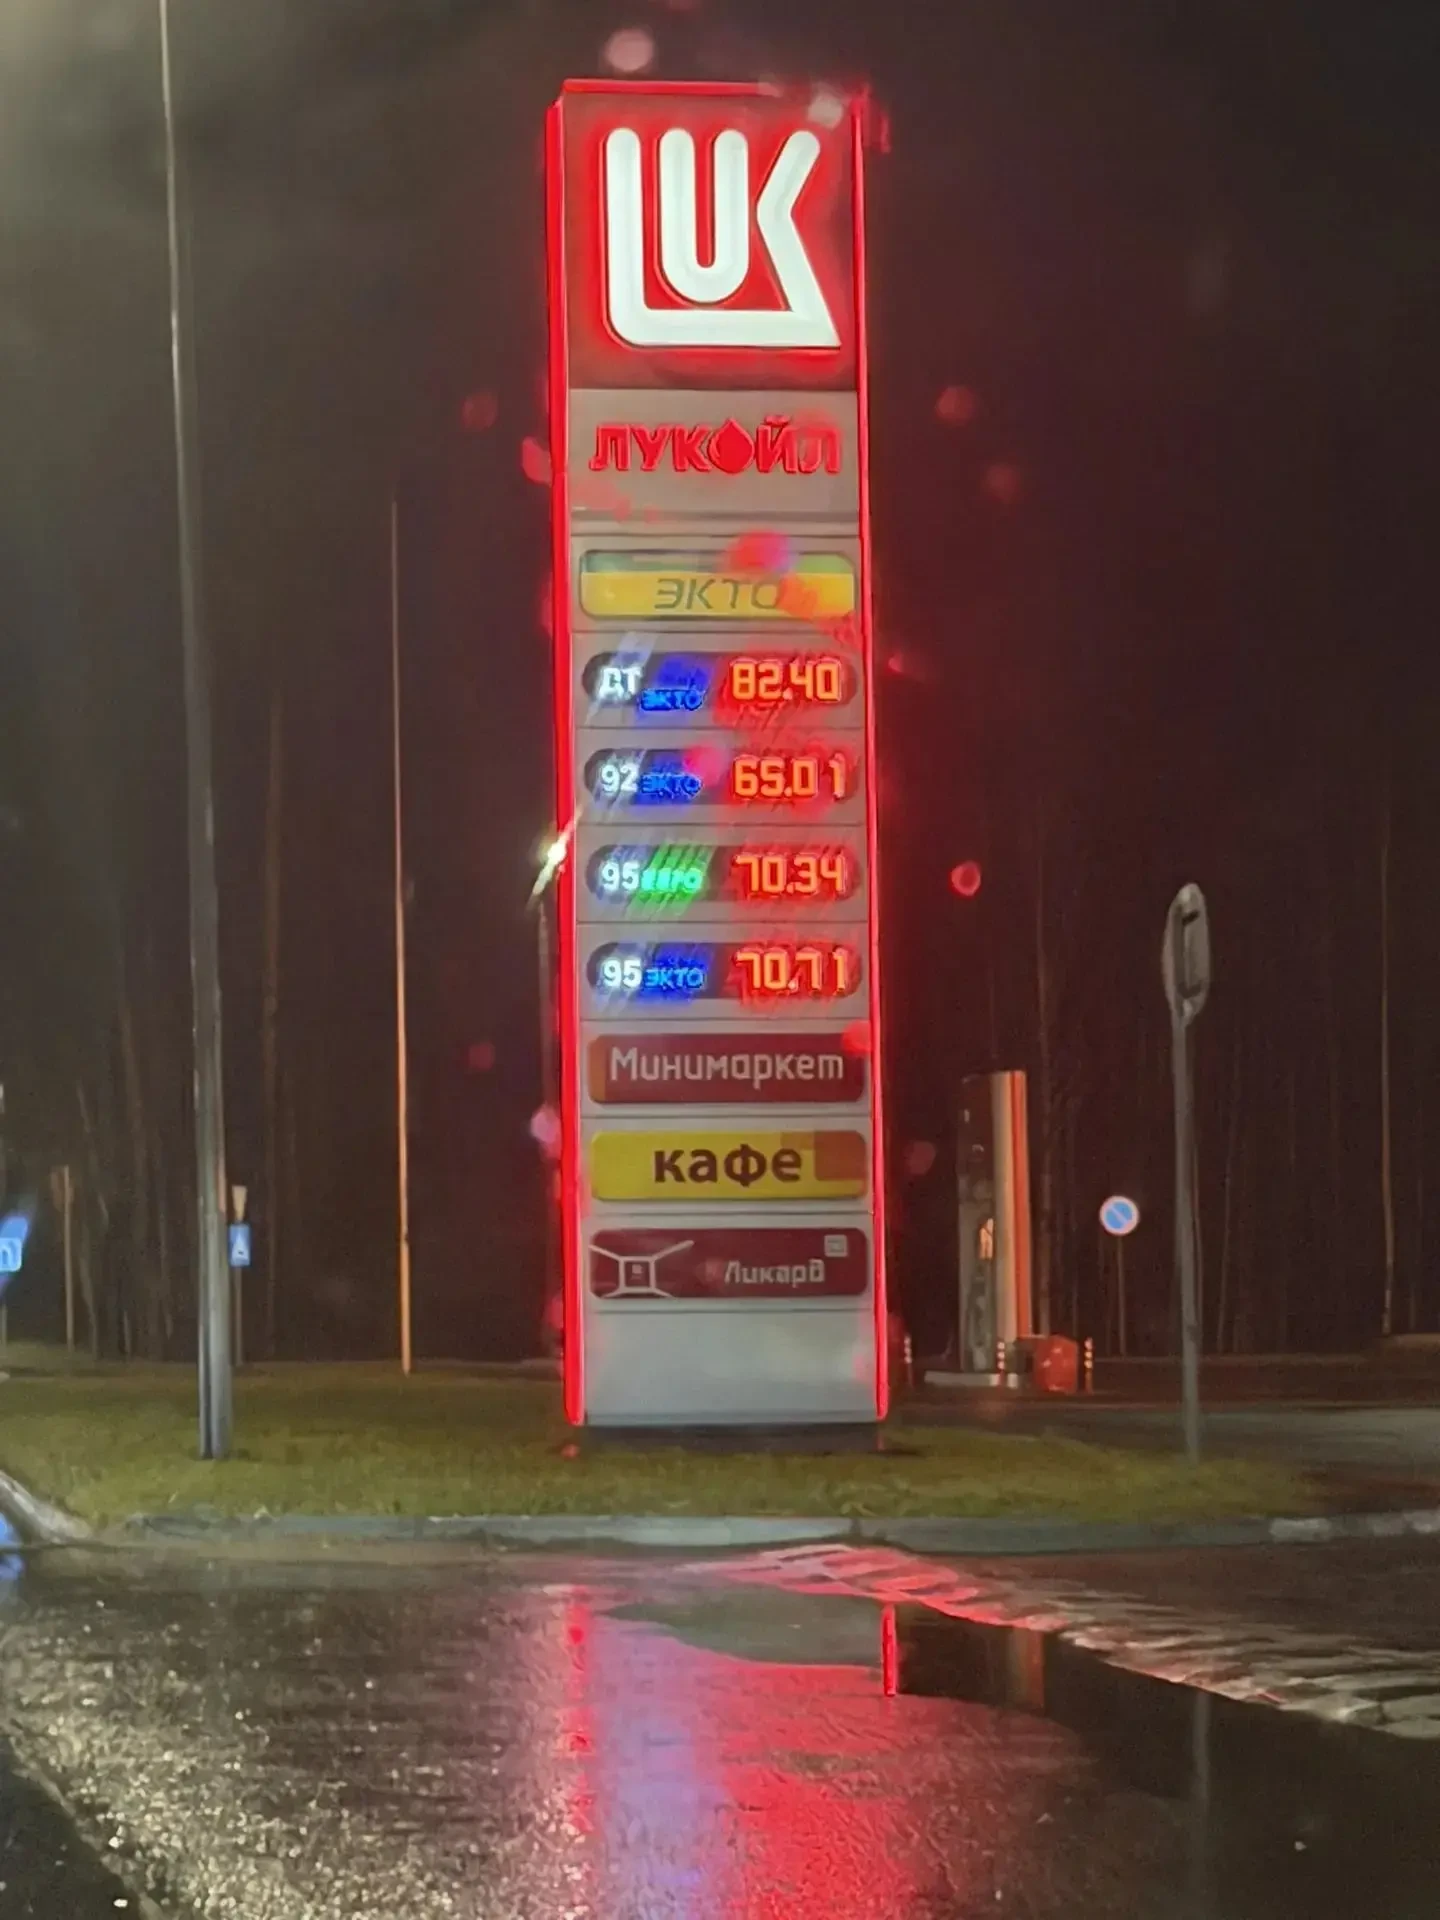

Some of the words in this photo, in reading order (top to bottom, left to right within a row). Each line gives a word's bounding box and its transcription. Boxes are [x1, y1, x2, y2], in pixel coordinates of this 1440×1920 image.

[589, 416, 842, 475] ЛУКОЙЛ
[598, 667, 641, 700] ДТ
[640, 688, 706, 711] ЭКТО
[731, 658, 842, 701] 82.40
[601, 764, 639, 793] 92
[733, 754, 846, 799] 65.01
[600, 862, 639, 891] 95
[735, 853, 846, 894] 70.34
[602, 958, 642, 988] 95
[644, 967, 705, 989] ЭКТО
[735, 948, 848, 992] 70.71
[609, 1046, 844, 1089] Минимаркет
[653, 1143, 803, 1188] кафе
